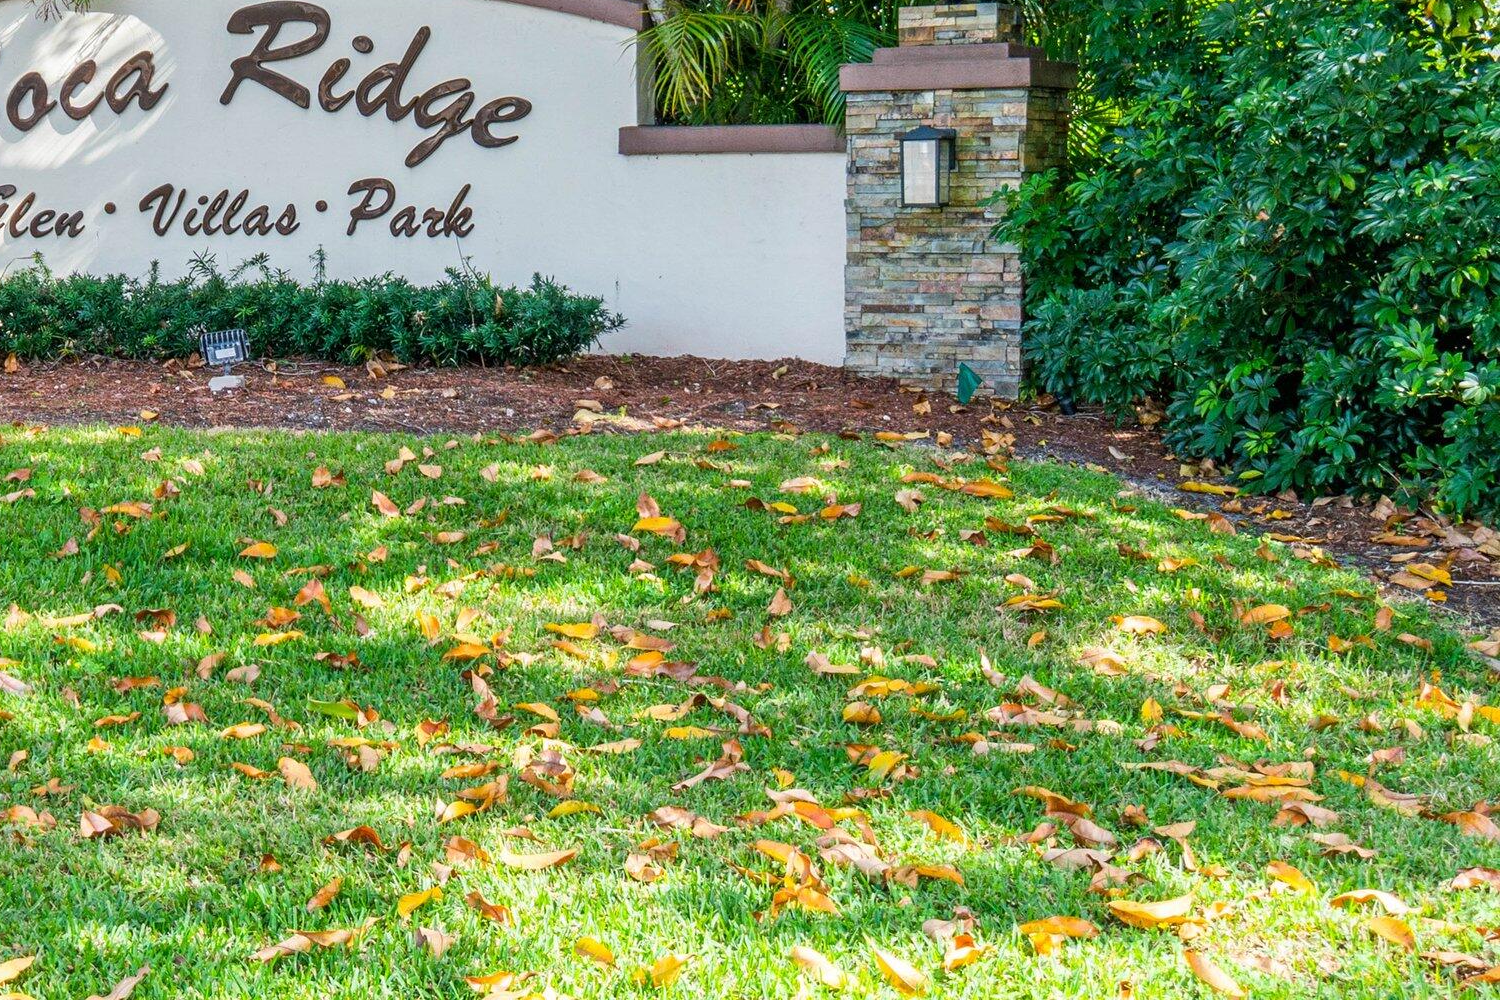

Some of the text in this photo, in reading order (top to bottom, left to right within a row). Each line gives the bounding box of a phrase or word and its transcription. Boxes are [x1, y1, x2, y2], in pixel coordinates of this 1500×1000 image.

[219, 0, 533, 168] Ridge
[139, 183, 301, 237] Villas
[346, 177, 475, 239] Park
